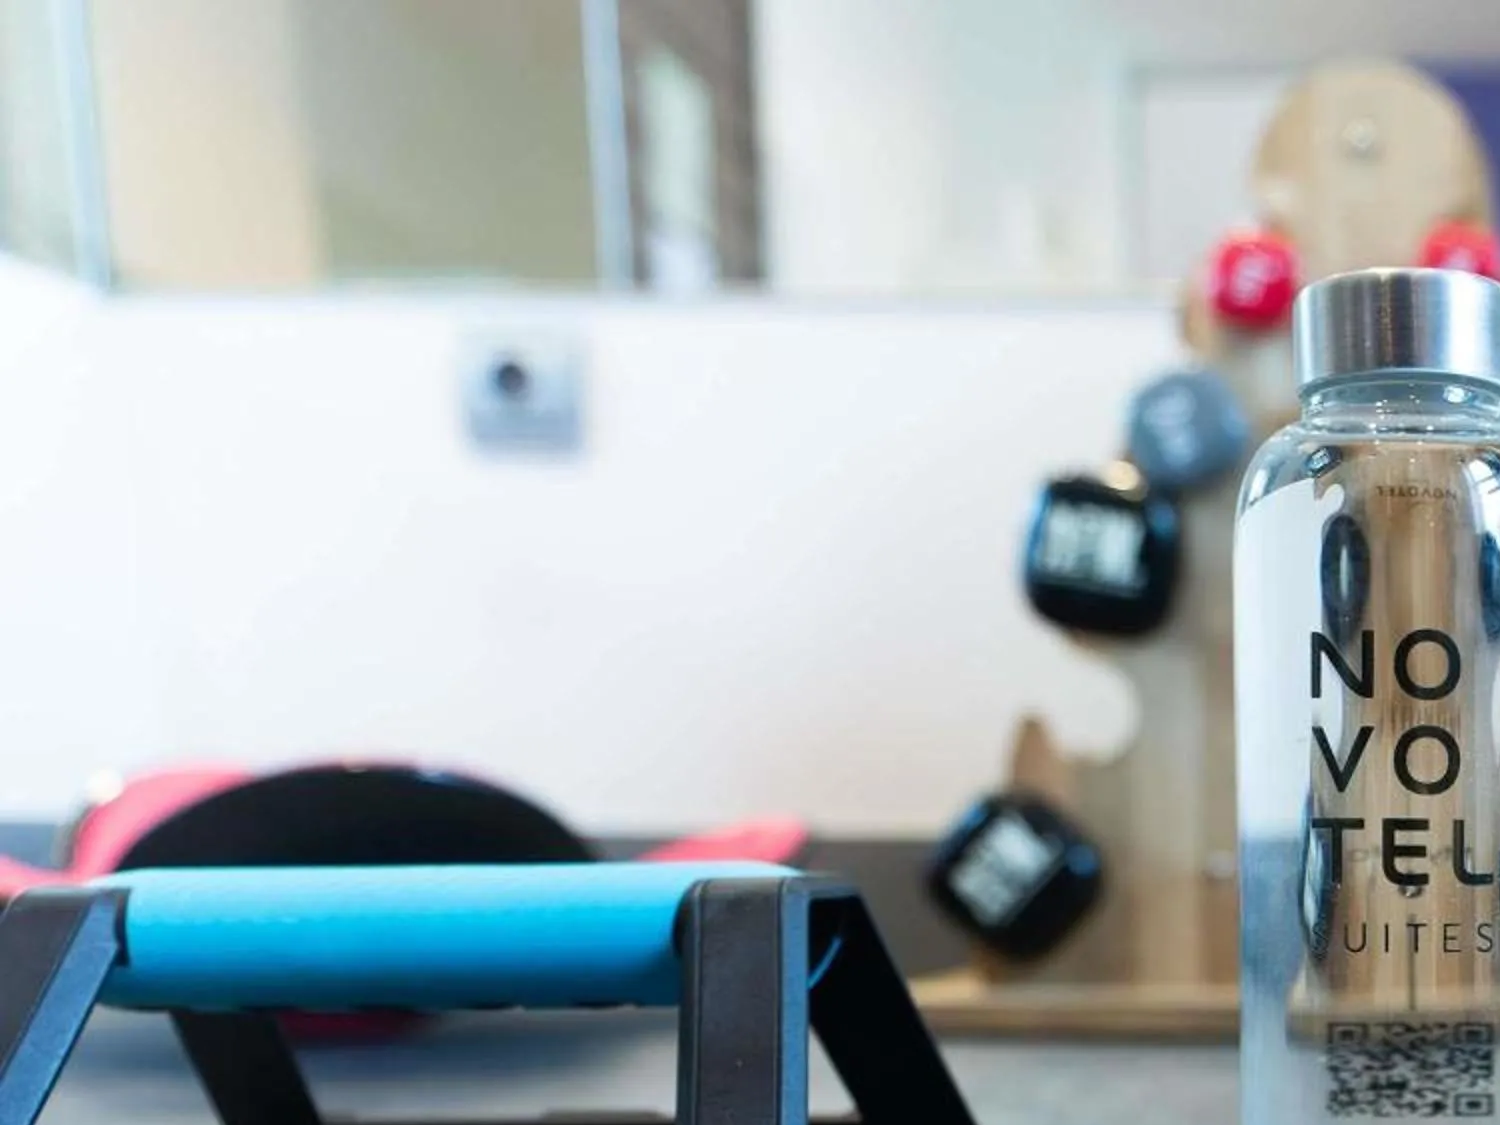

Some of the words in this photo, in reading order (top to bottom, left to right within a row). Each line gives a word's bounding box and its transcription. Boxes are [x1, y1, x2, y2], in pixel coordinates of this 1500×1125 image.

[1311, 629, 1461, 700] NO
[1311, 725, 1461, 796] VO
[1311, 818, 1494, 887] TEL
